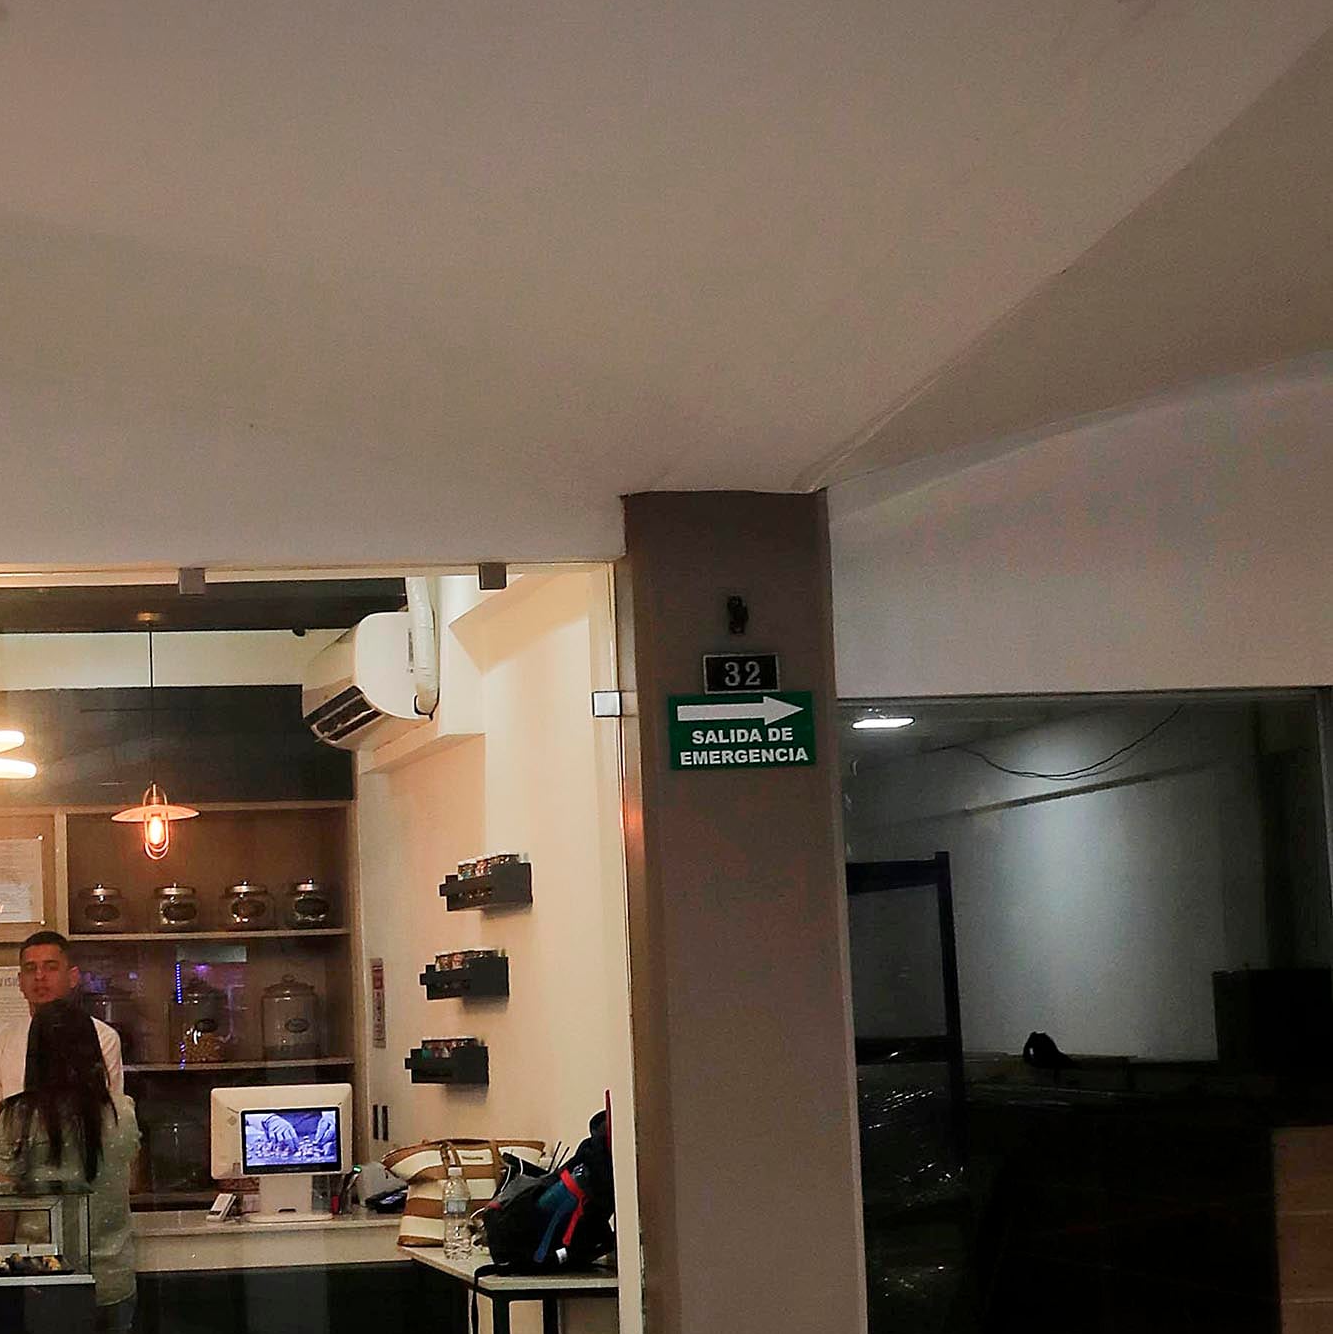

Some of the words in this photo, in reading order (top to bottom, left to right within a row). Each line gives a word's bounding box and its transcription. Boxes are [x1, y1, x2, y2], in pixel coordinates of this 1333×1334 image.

[724, 661, 762, 687] 32
[691, 728, 763, 745] SALIDA
[767, 727, 794, 742] DE
[679, 747, 809, 766] EMERGENCIA
